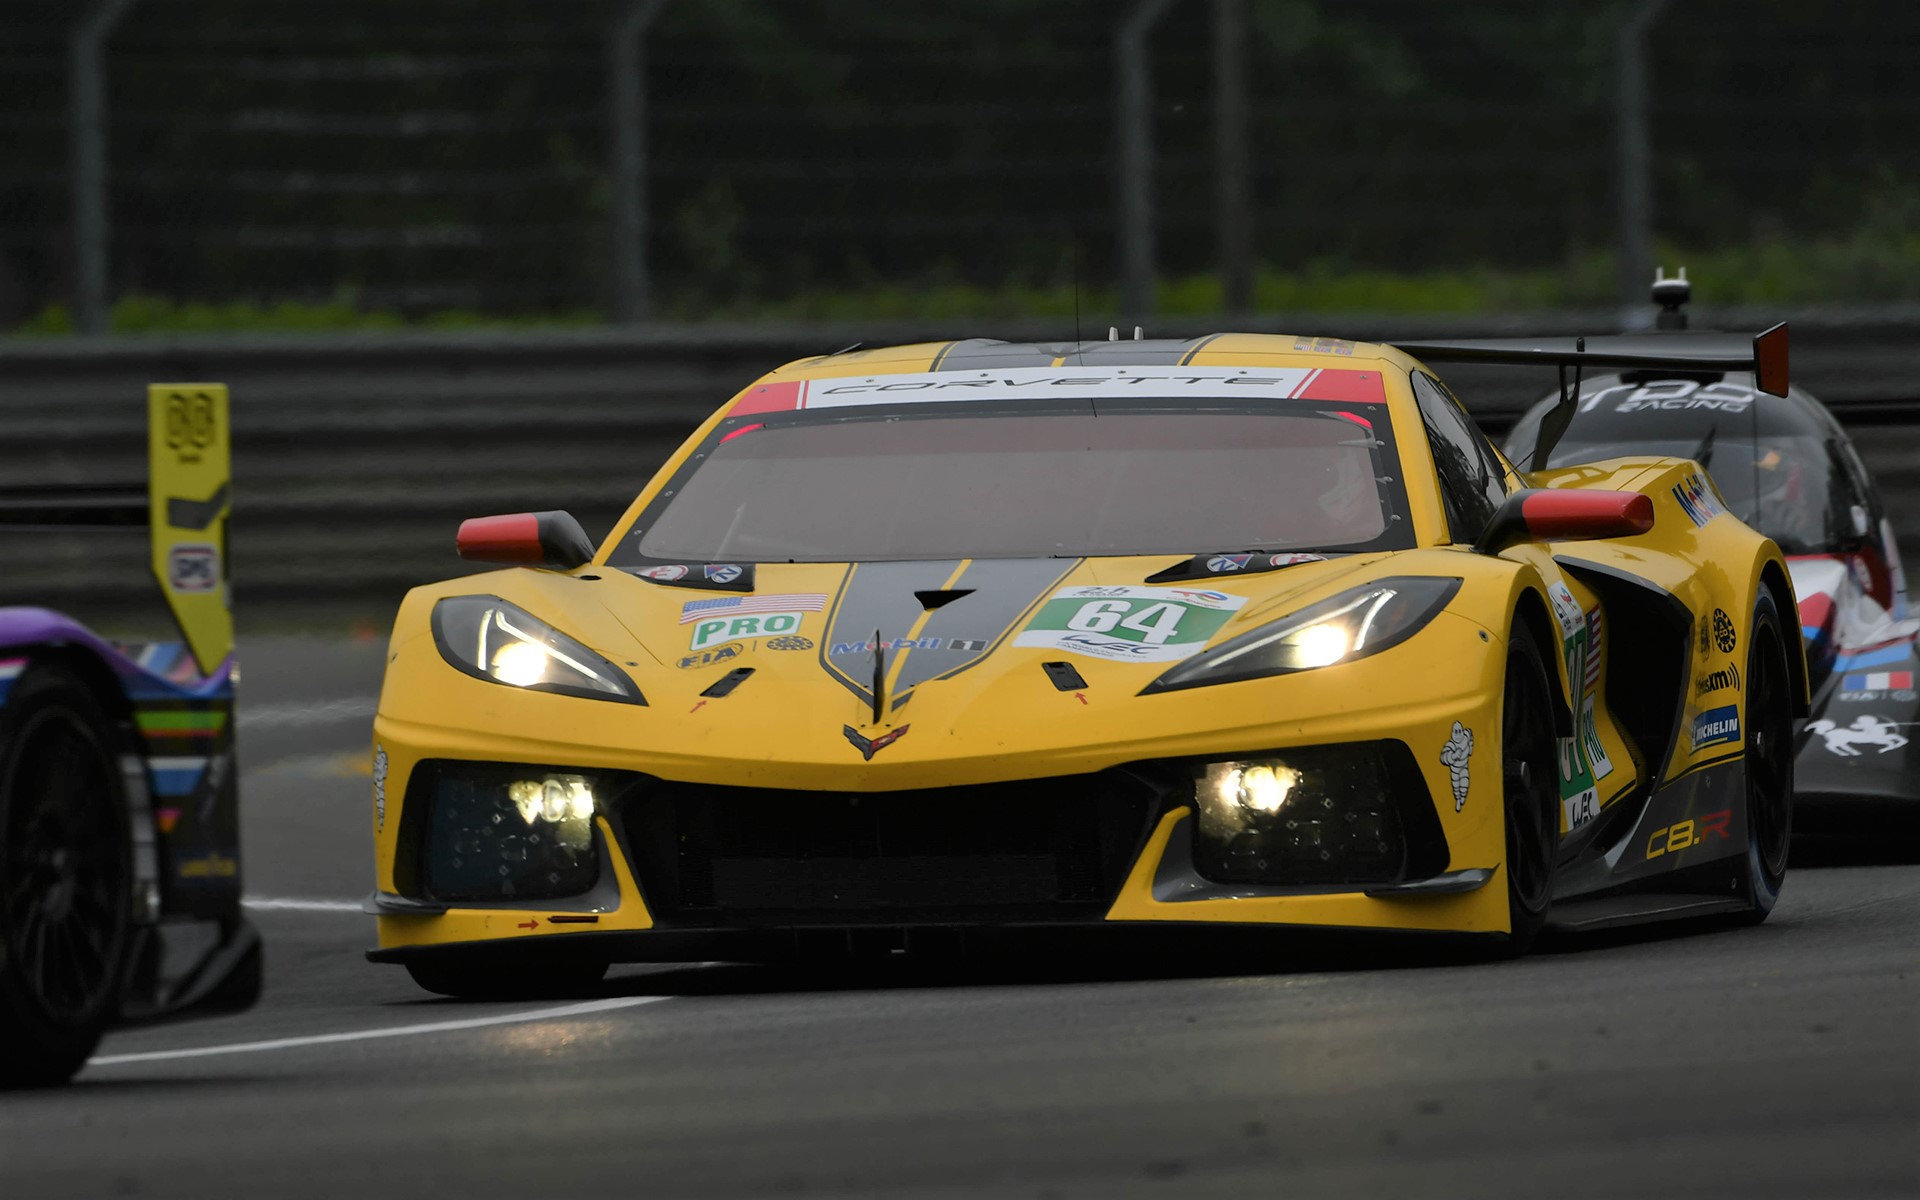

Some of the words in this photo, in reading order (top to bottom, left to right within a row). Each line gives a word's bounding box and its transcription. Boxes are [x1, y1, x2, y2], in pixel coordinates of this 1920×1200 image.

[821, 376, 1284, 395] CORVETTE
[1615, 400, 1747, 413] RACING
[696, 615, 796, 646] PRO
[1066, 600, 1188, 645] 64
[680, 646, 737, 668] FIA
[830, 637, 942, 655] Mobil
[1695, 718, 1738, 742] MICHELIN
[1646, 808, 1732, 860] C8.R
